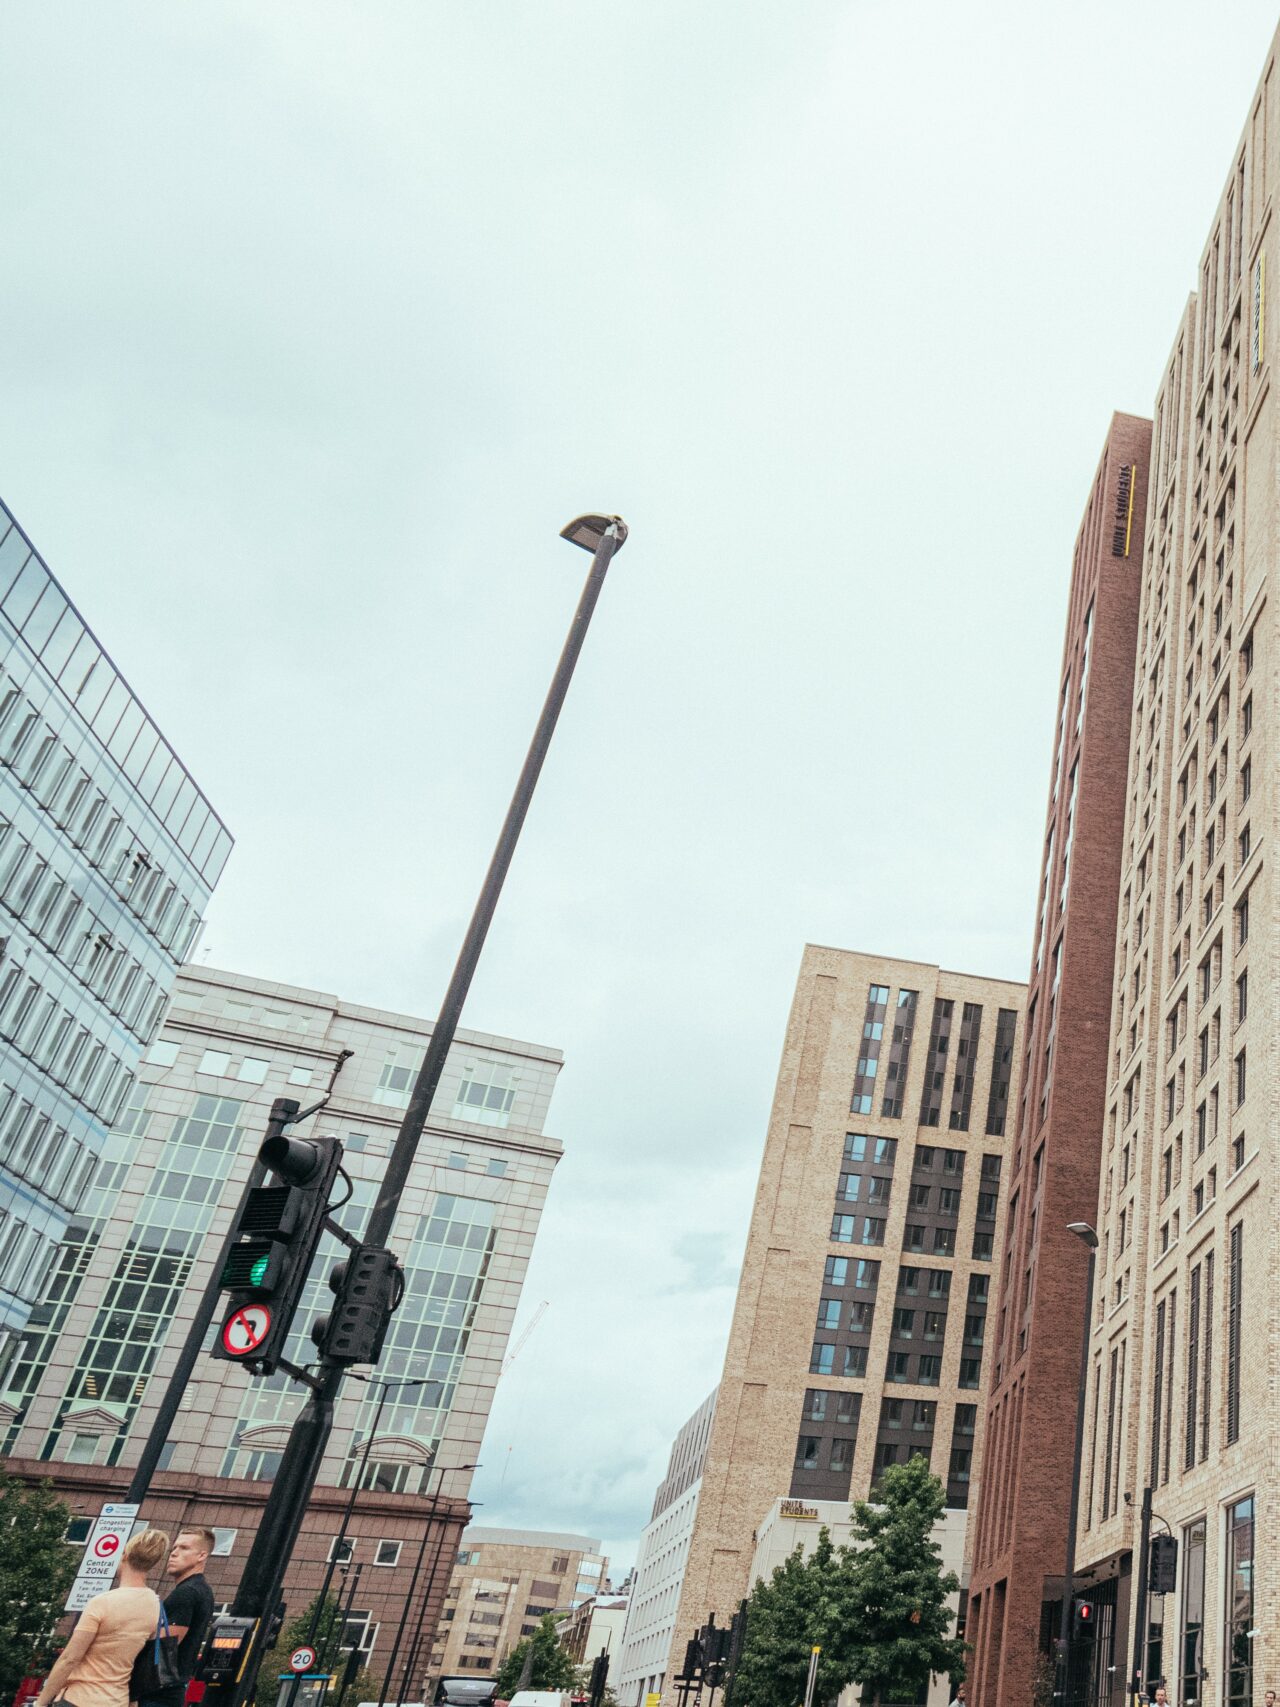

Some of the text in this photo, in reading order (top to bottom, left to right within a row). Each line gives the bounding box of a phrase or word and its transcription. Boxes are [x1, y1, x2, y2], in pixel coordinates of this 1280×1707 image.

[780, 1500, 803, 1508] UNITE
[780, 1506, 818, 1515] STUDENTS
[214, 1638, 240, 1648] WAIT
[293, 1654, 310, 1664] 20
